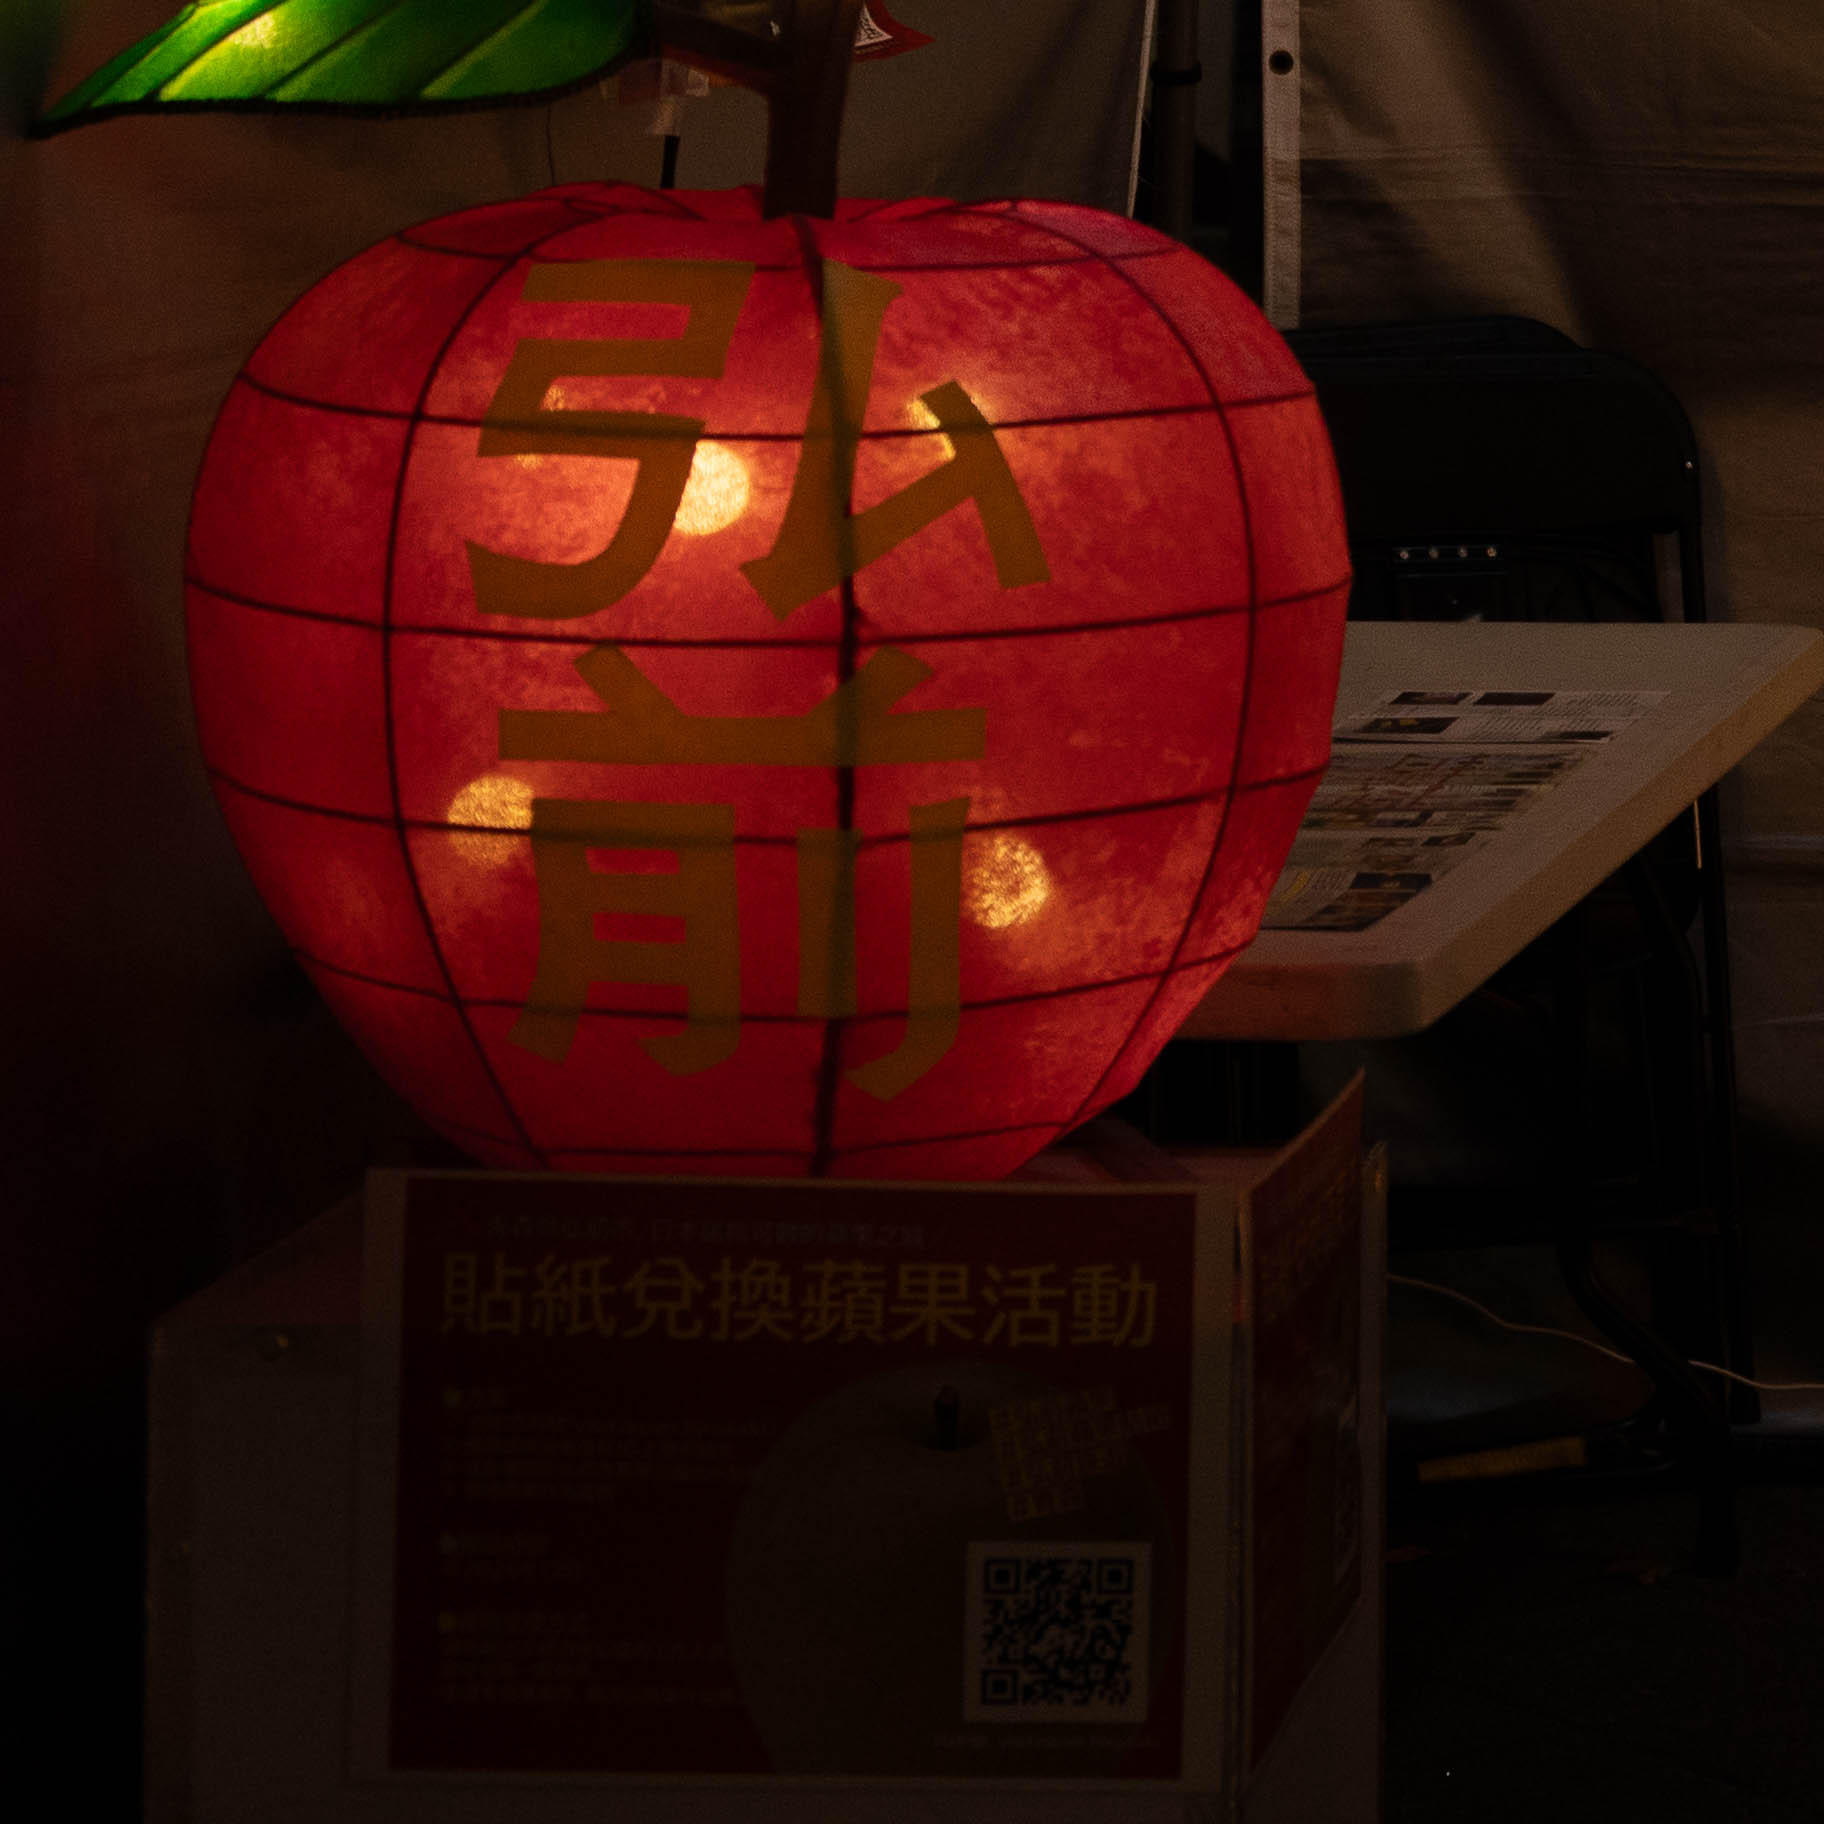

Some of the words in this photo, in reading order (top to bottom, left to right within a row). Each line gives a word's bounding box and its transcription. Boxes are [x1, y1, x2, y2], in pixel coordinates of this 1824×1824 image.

[464, 258, 1052, 1102] 弘前
[440, 1249, 1160, 1348] 貼紙兌換蘋果活動
